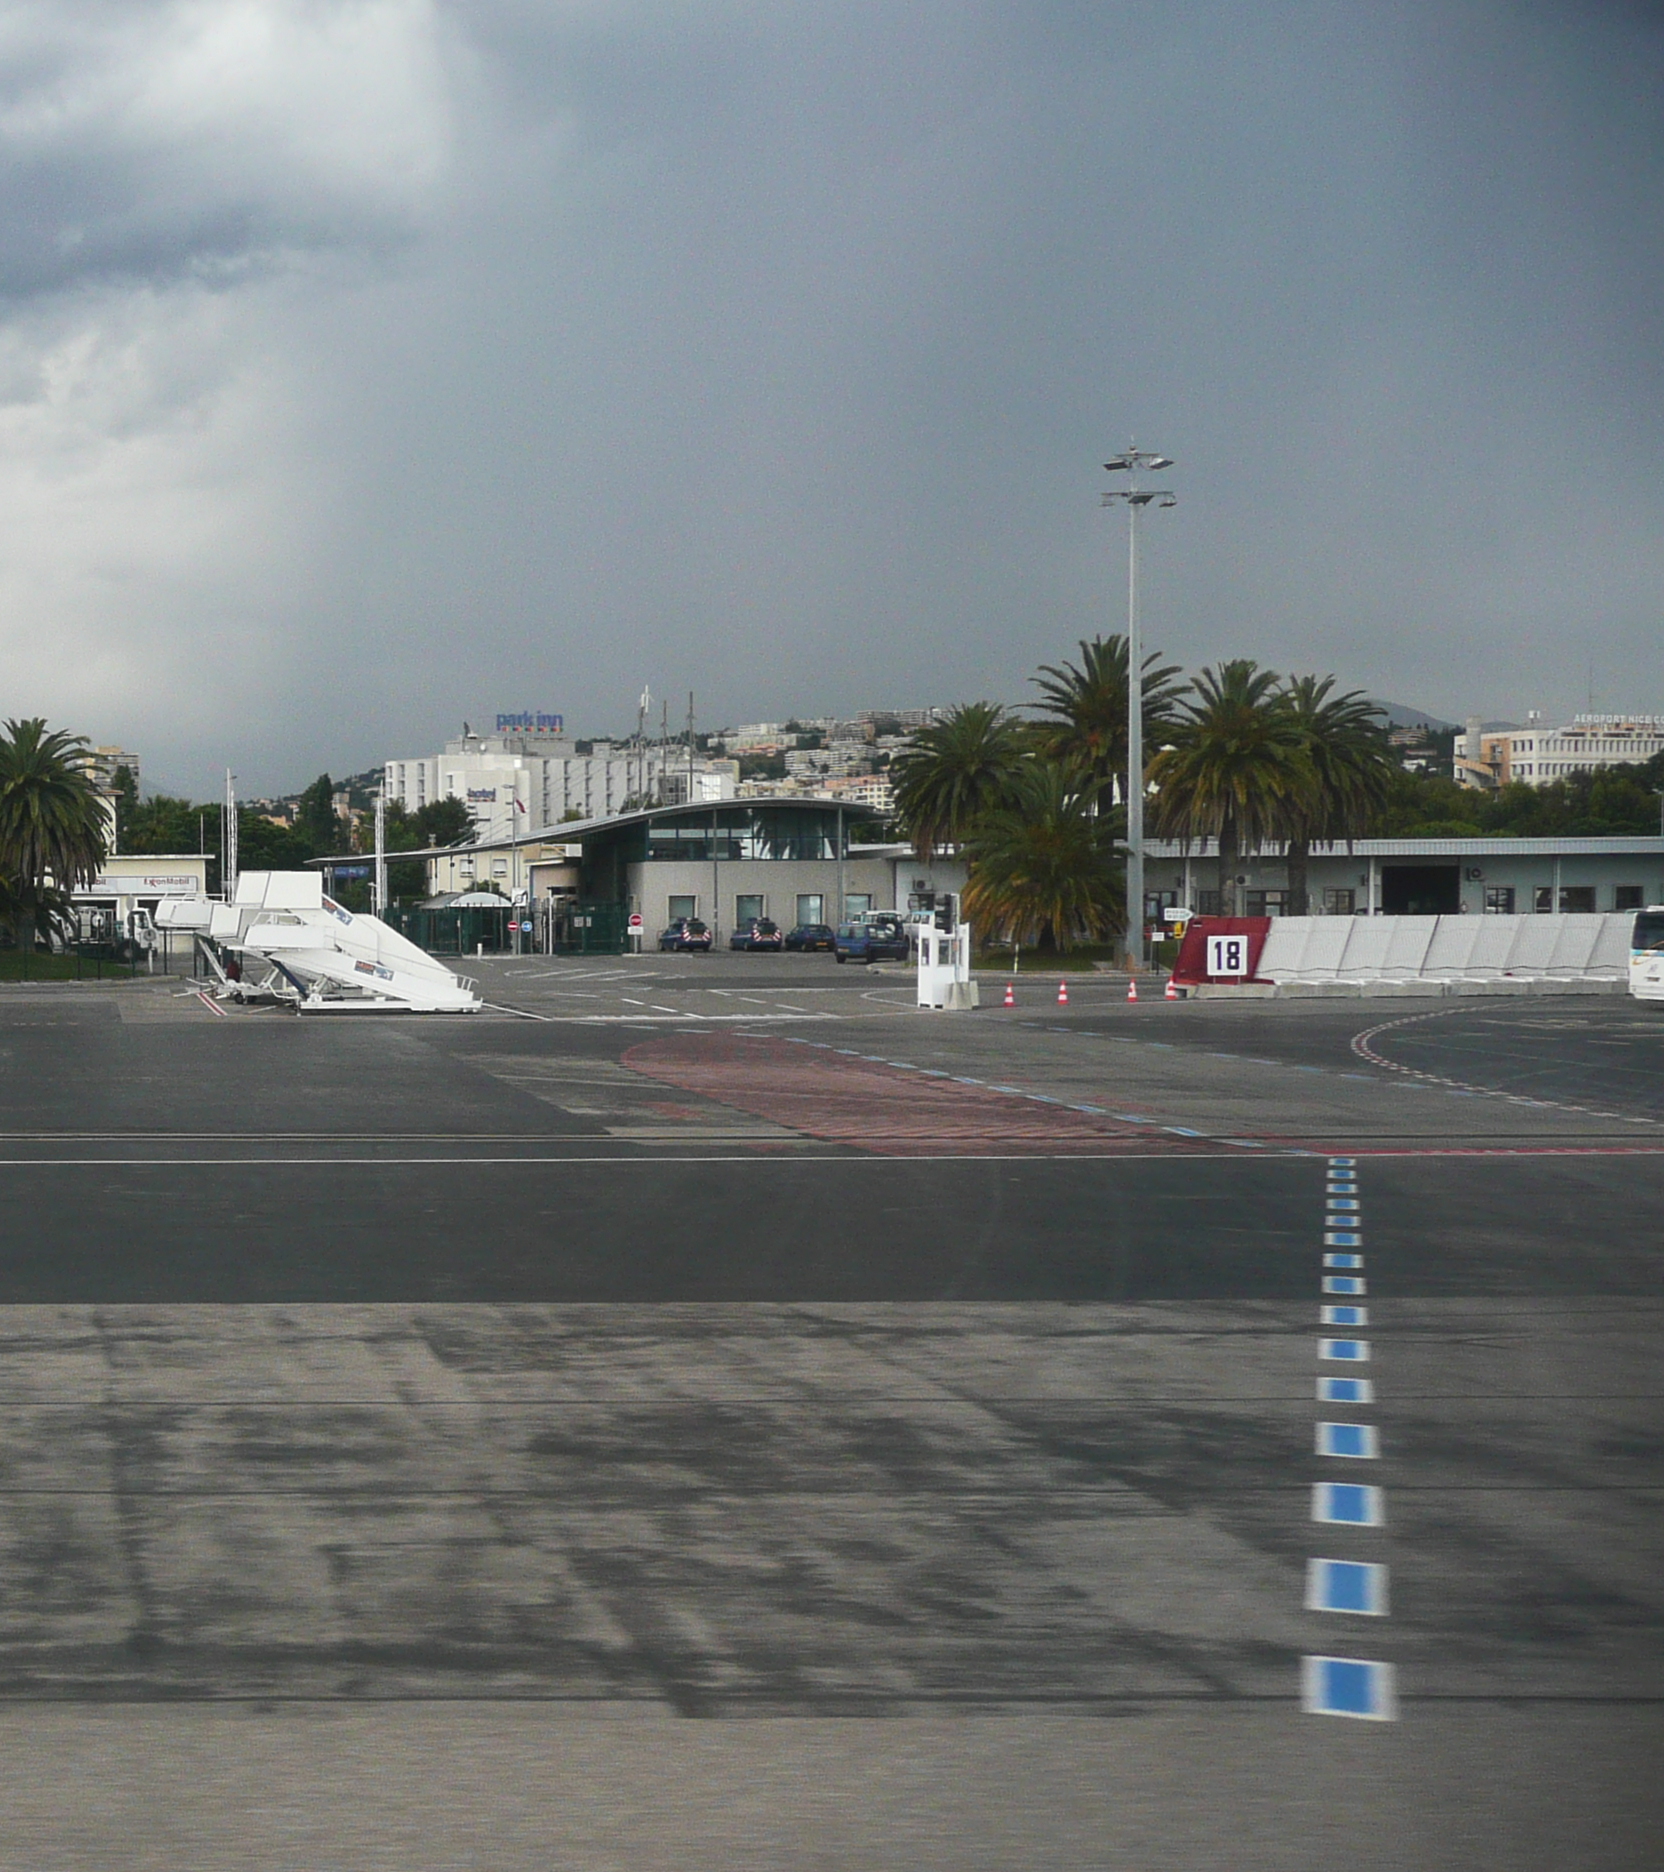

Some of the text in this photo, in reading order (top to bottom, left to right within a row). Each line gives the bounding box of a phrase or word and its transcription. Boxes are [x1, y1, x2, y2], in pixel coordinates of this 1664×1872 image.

[496, 710, 563, 731] park inn
[1574, 713, 1626, 724] AEROPORT
[1628, 714, 1652, 724] NICE
[467, 787, 496, 799] hotel
[1214, 940, 1240, 971] 18
